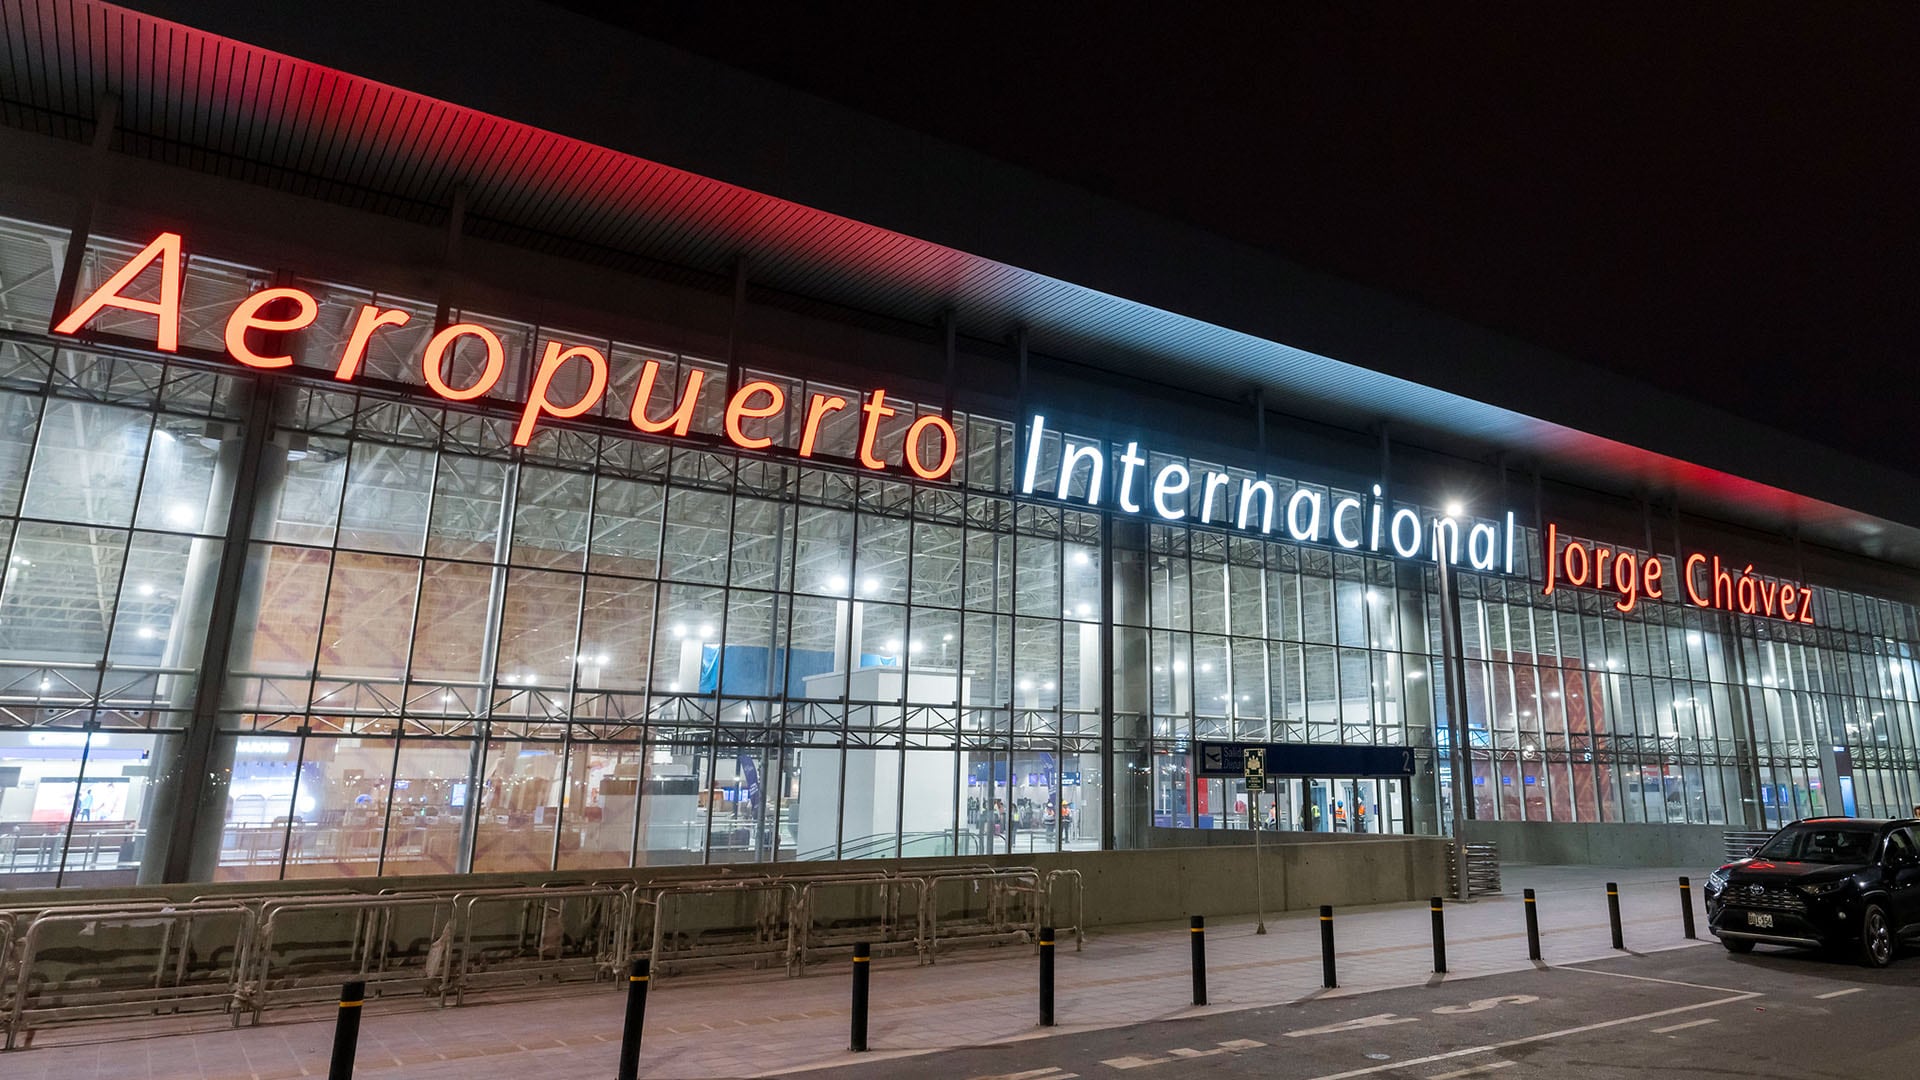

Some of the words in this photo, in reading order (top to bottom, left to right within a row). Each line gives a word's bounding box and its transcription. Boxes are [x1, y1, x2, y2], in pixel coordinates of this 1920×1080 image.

[54, 231, 958, 480] Aeropuerto
[1021, 414, 1515, 574] Internacional
[1544, 523, 1663, 613] Jorge
[1685, 552, 1815, 625] Chávez
[1402, 751, 1411, 771] 2
